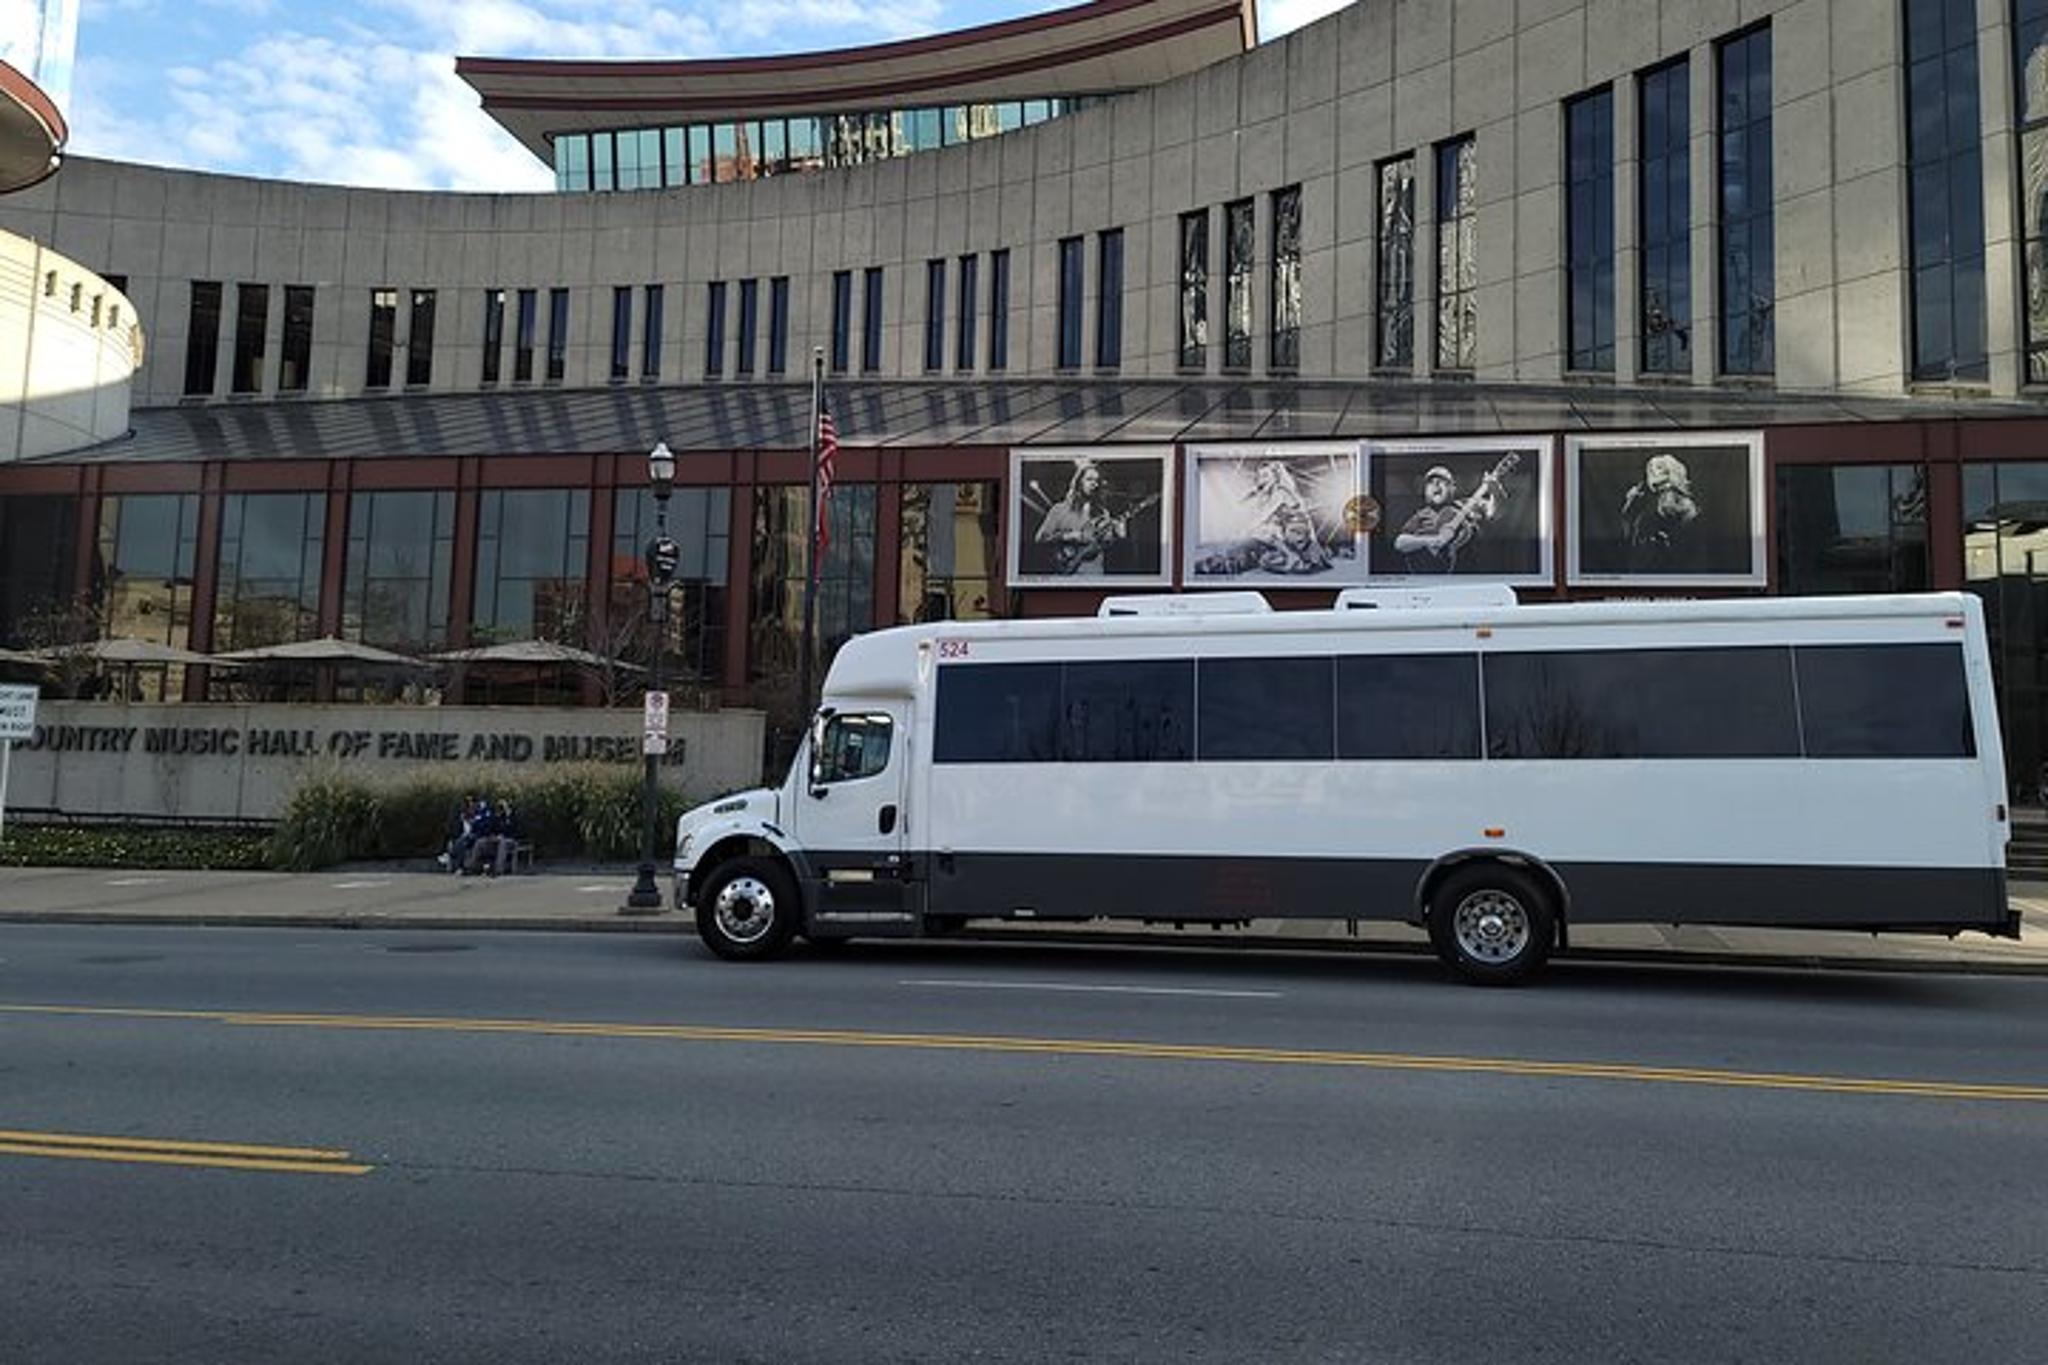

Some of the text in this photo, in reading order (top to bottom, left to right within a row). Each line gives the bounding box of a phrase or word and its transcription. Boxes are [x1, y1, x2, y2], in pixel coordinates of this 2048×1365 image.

[940, 642, 968, 657] 524
[10, 724, 136, 751] OUNTRY
[144, 727, 240, 754] MUSIC
[247, 729, 319, 756] HALL
[327, 731, 371, 757] OF
[378, 731, 460, 760] FAME
[465, 733, 533, 762] AND
[543, 734, 687, 766] MUSEM
